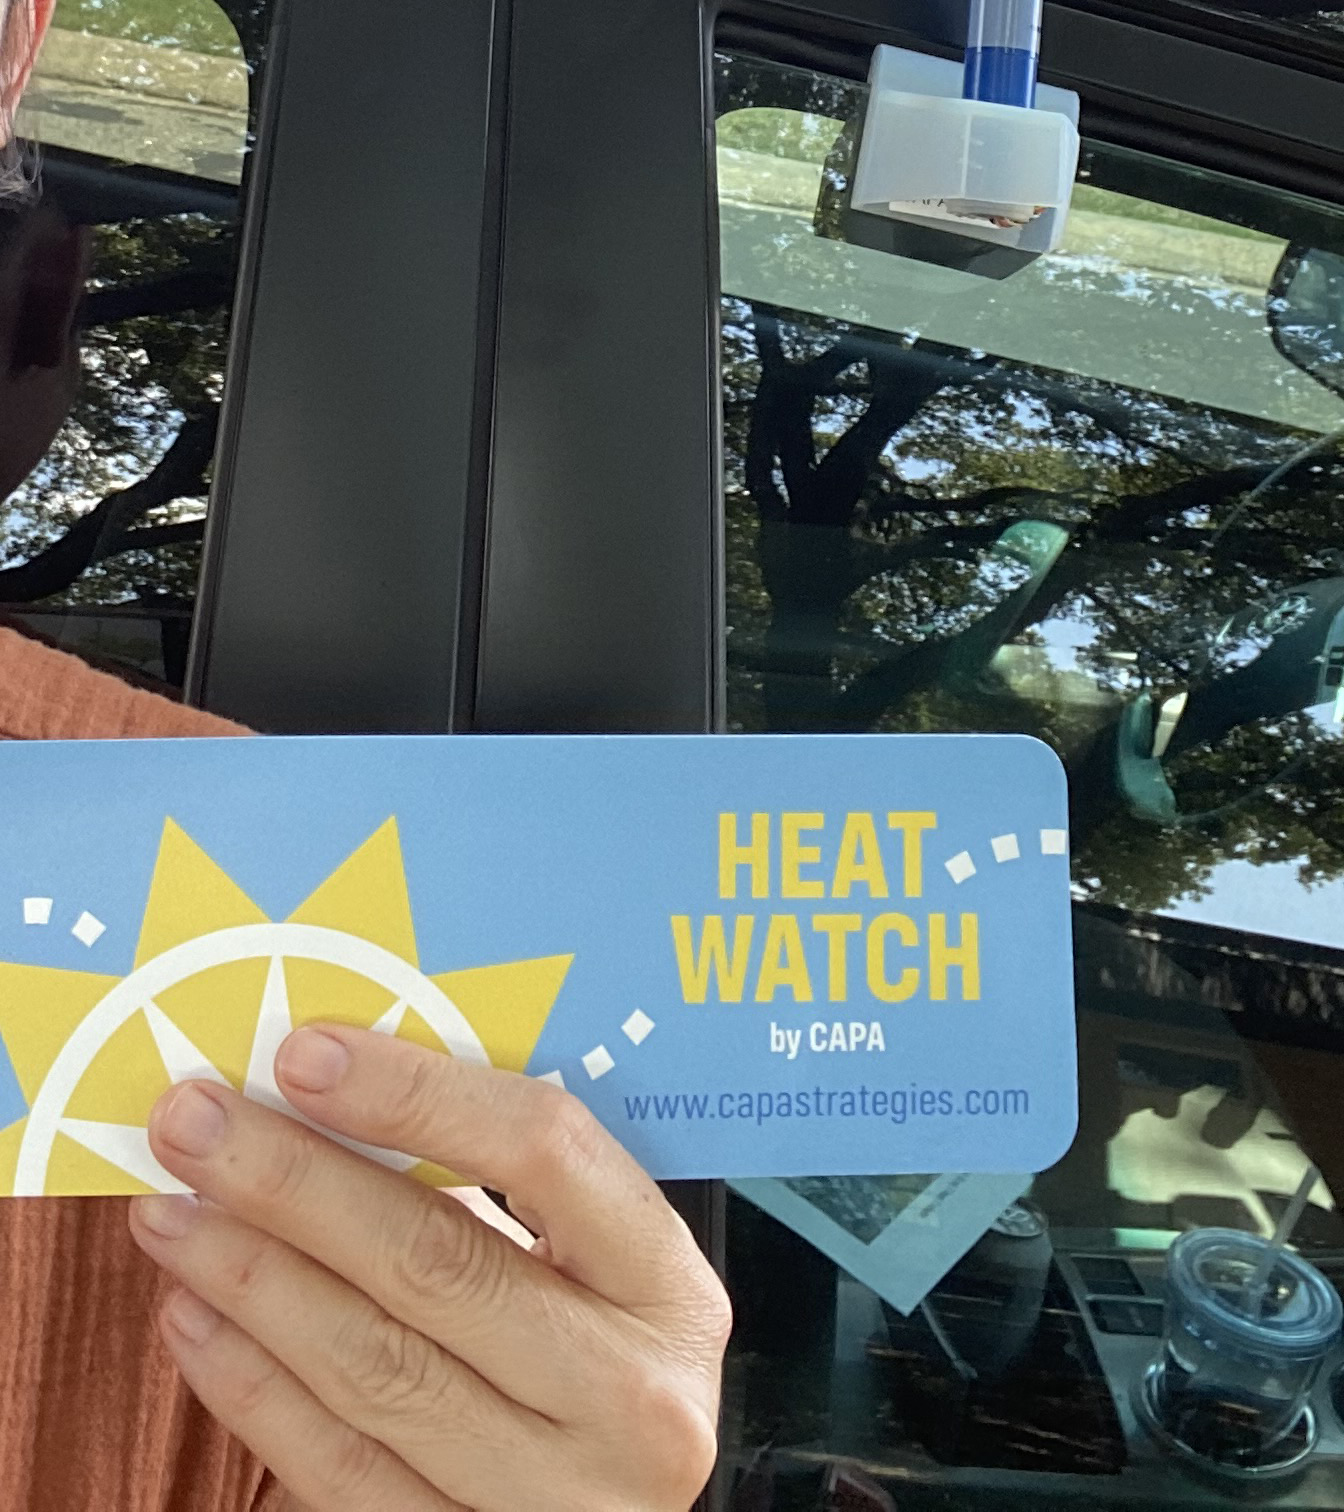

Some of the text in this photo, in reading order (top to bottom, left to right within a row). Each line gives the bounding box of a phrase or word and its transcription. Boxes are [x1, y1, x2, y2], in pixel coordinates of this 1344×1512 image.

[718, 811, 938, 900] HEAT
[670, 912, 981, 1005] WATCH
[769, 1021, 886, 1060] by CAPA
[623, 1082, 1030, 1125] www.capastrategies.com
